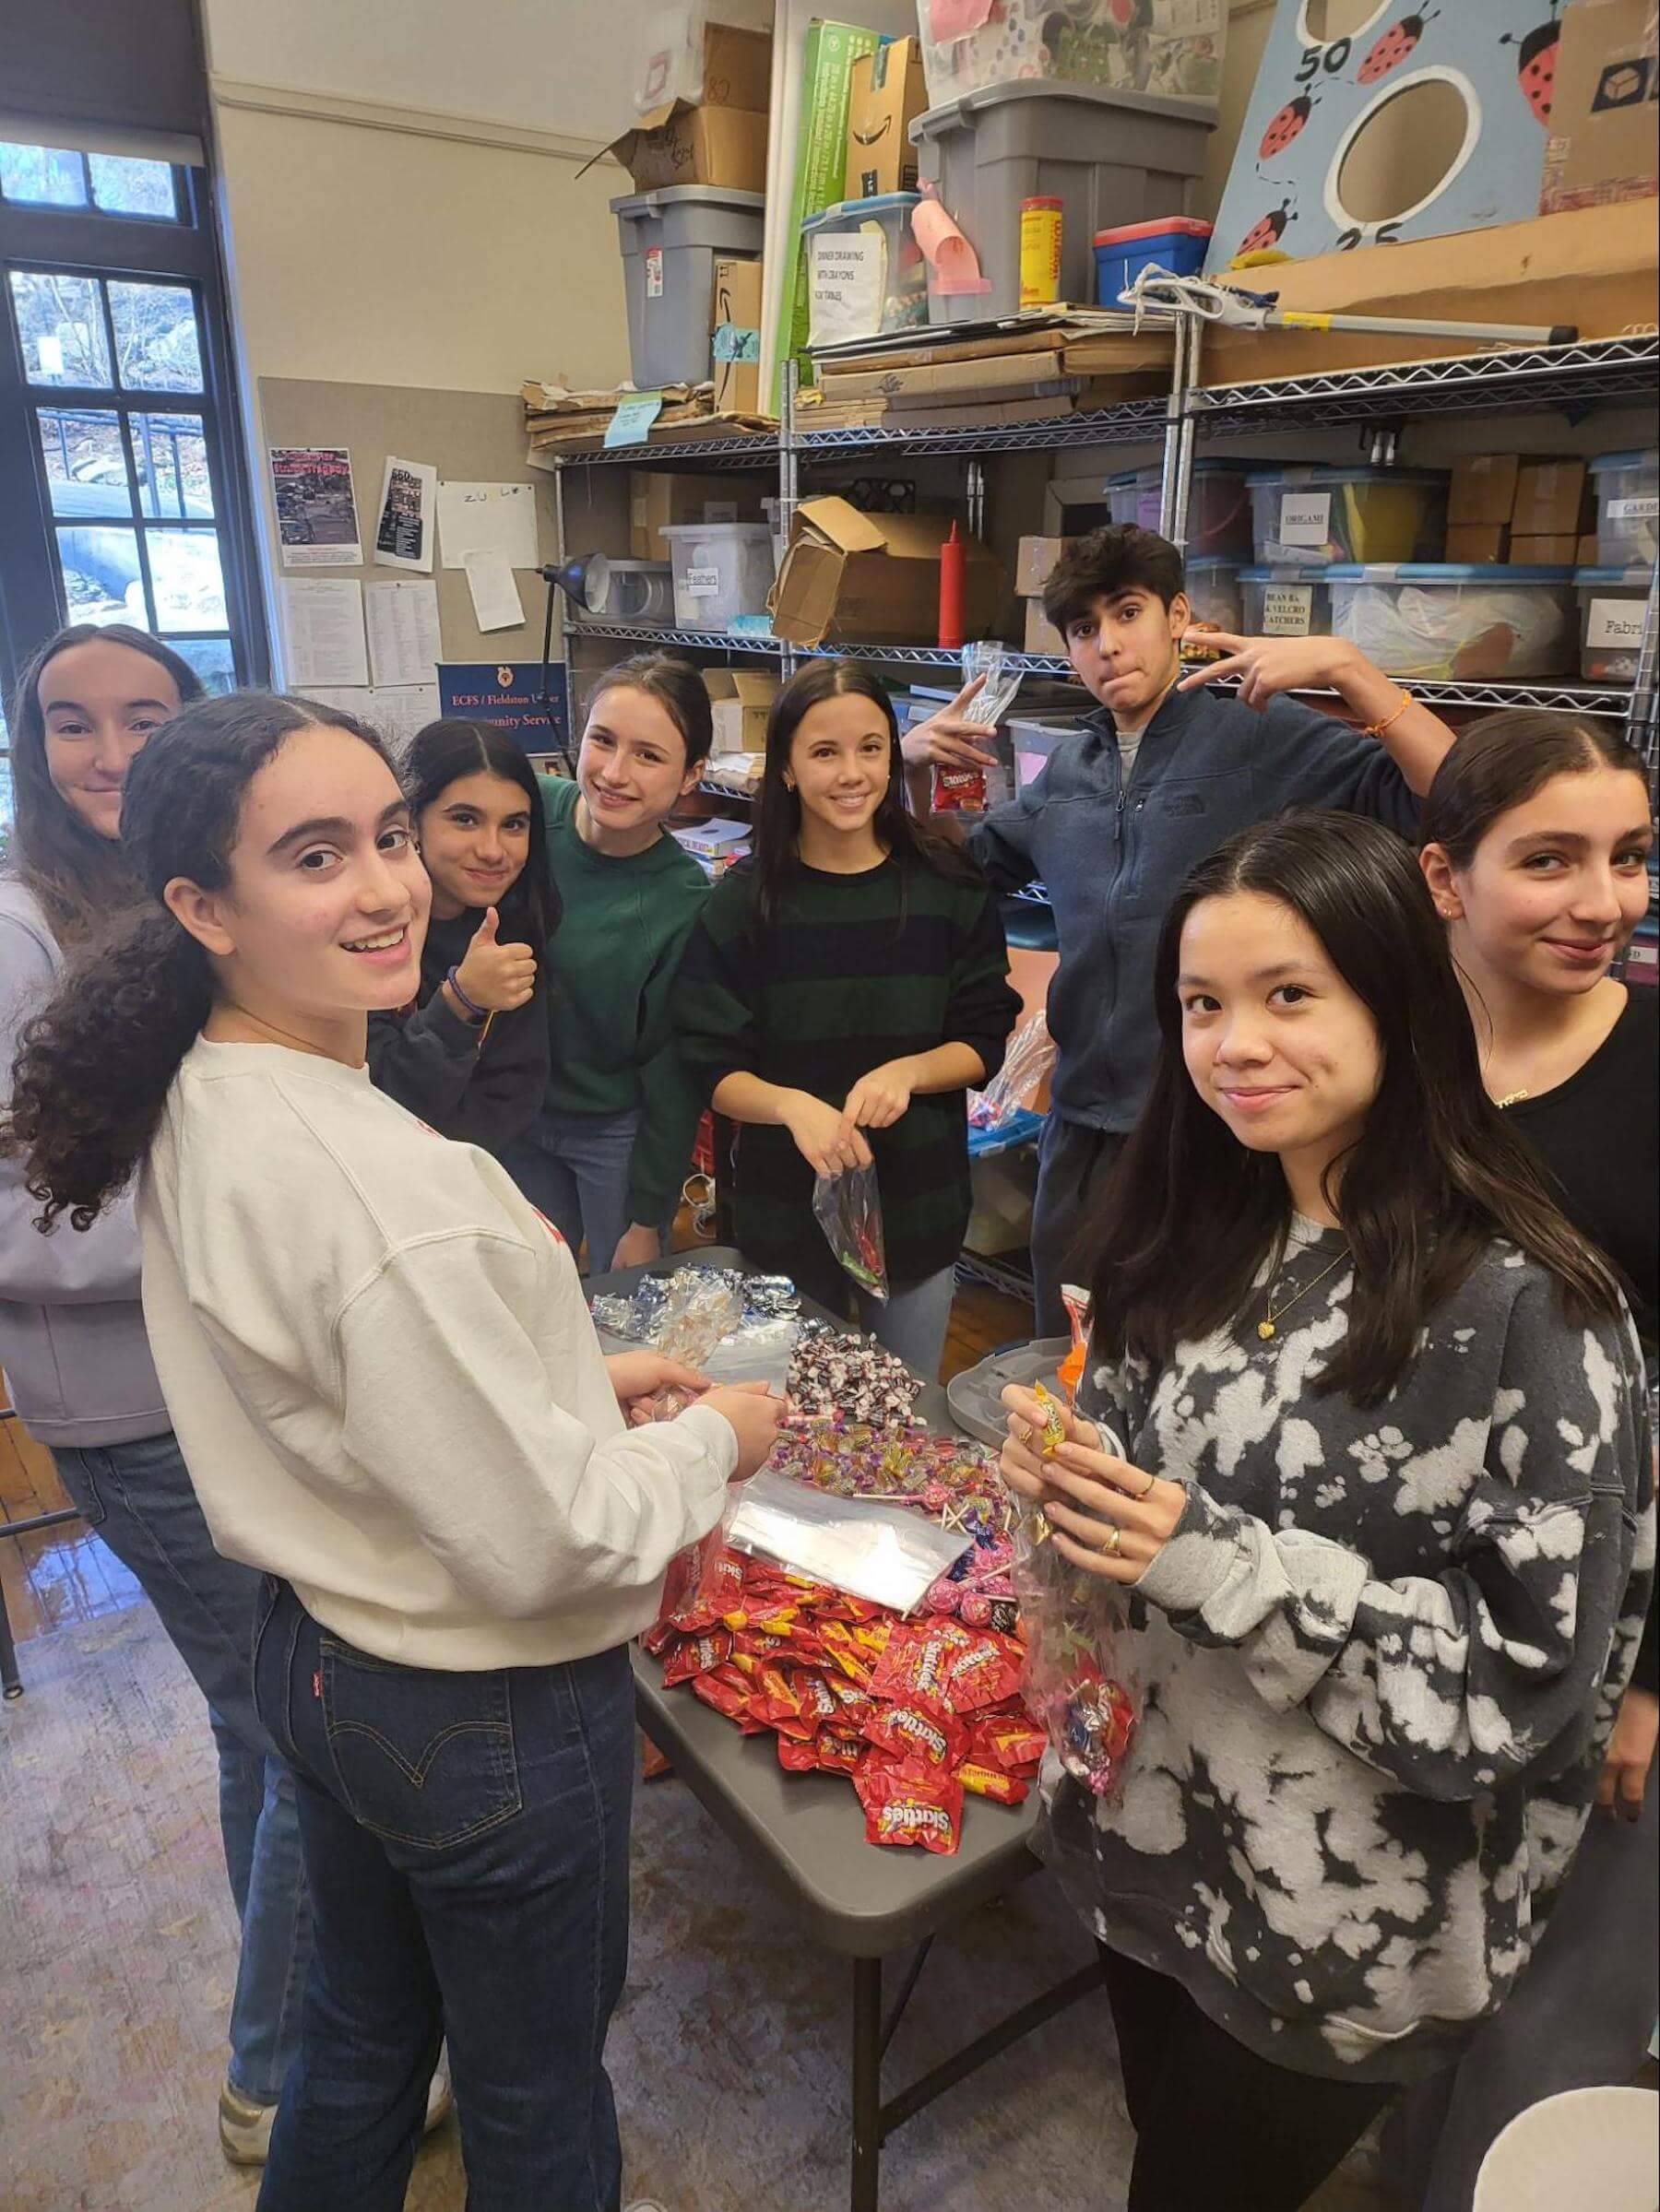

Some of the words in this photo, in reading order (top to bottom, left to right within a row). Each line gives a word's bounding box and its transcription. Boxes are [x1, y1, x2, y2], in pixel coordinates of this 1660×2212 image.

[1294, 38, 1351, 82] 50
[1286, 514, 1323, 524] ORIGAMI
[1273, 605, 1306, 613] VELCRO
[453, 695, 479, 706] ECFS
[488, 693, 528, 705] Fieldston
[523, 715, 561, 725] Servie
[882, 1804, 950, 1831] Skittles
